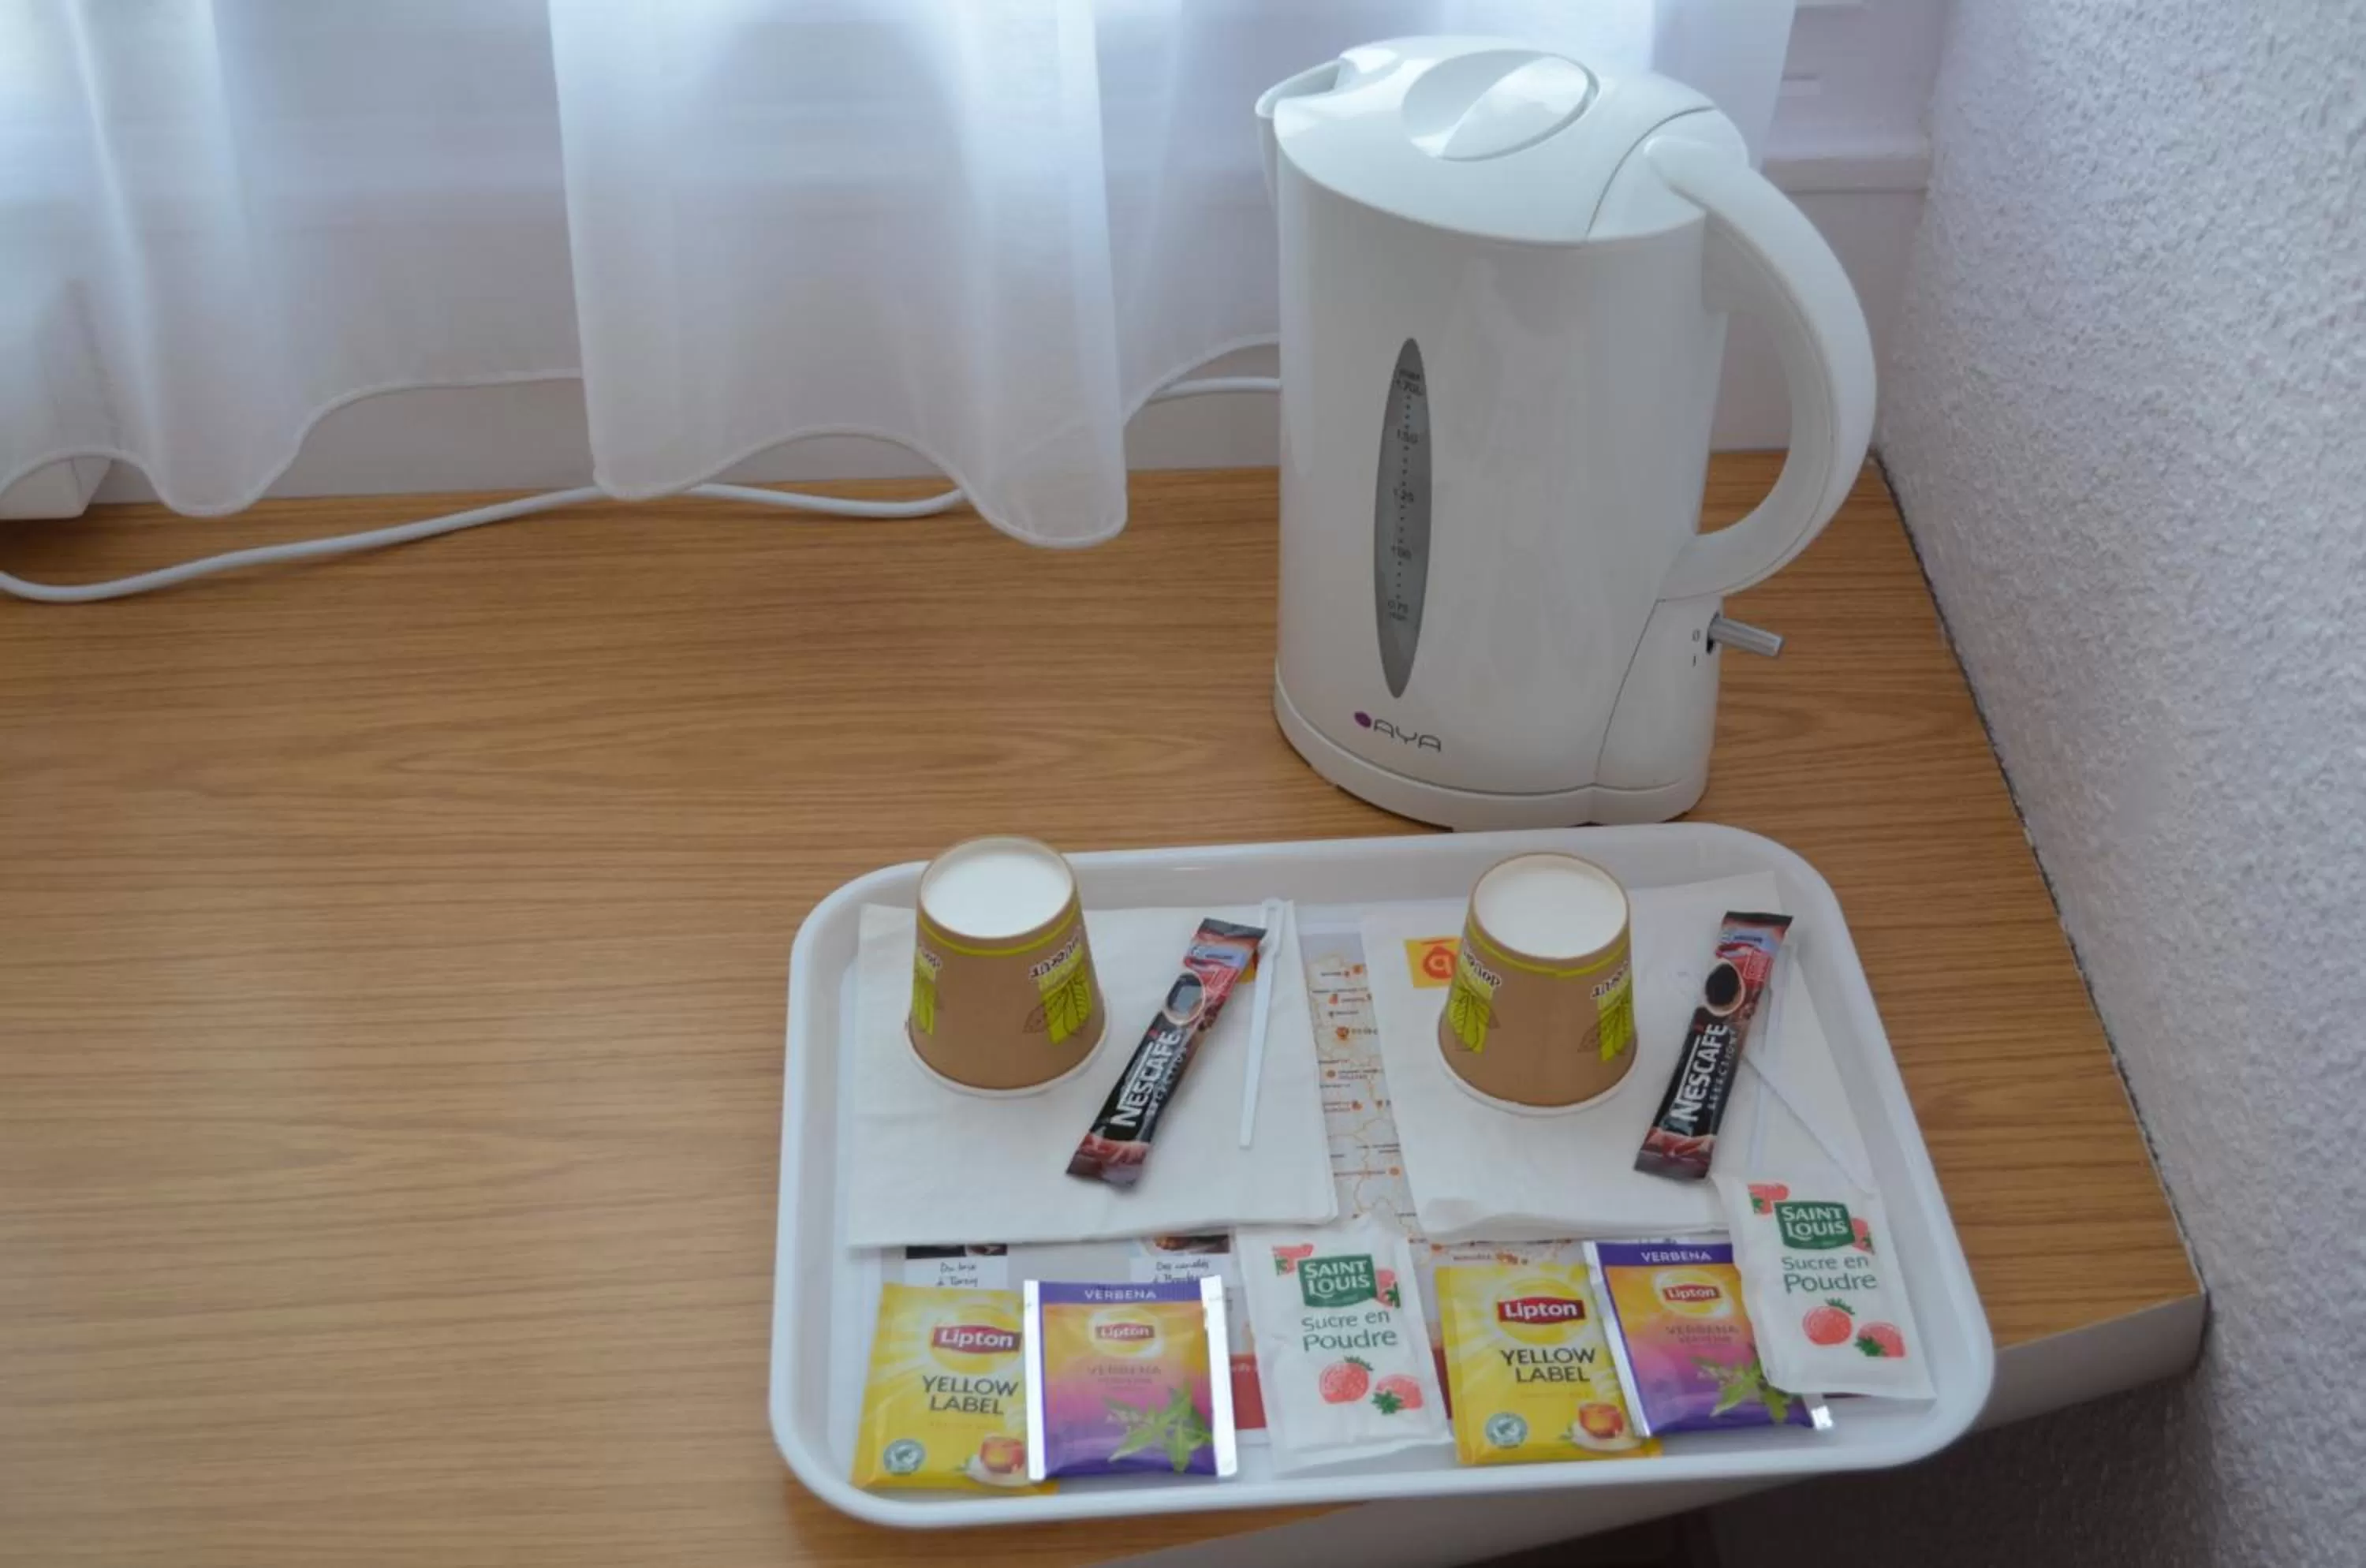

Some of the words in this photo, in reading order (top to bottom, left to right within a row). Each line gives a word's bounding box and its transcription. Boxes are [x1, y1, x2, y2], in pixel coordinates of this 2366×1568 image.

[1373, 719, 1442, 753] AYA
[1781, 1206, 1844, 1222] SAINT
[1786, 1220, 1849, 1241] LOUIS
[1640, 1250, 1713, 1263] VERBENA
[1781, 1256, 1838, 1271] Sucre
[1844, 1254, 1868, 1269] en
[1304, 1260, 1369, 1279] SAINT
[1308, 1274, 1371, 1299] LOUIS
[1784, 1273, 1879, 1294] Poudre
[1084, 1289, 1158, 1301] VERBENA
[1666, 1287, 1717, 1300] Lipton
[1504, 1301, 1578, 1320] Lipton
[1301, 1315, 1358, 1332] Sucre
[1364, 1309, 1390, 1324] en
[940, 1328, 1014, 1348] Lipton
[1101, 1326, 1150, 1338] Lipton
[1303, 1328, 1399, 1353] Poudre
[1501, 1347, 1595, 1366] YELLOW
[1515, 1365, 1591, 1383] LABEL
[922, 1374, 1020, 1397] YELLOW
[929, 1393, 1004, 1415] LABEL
